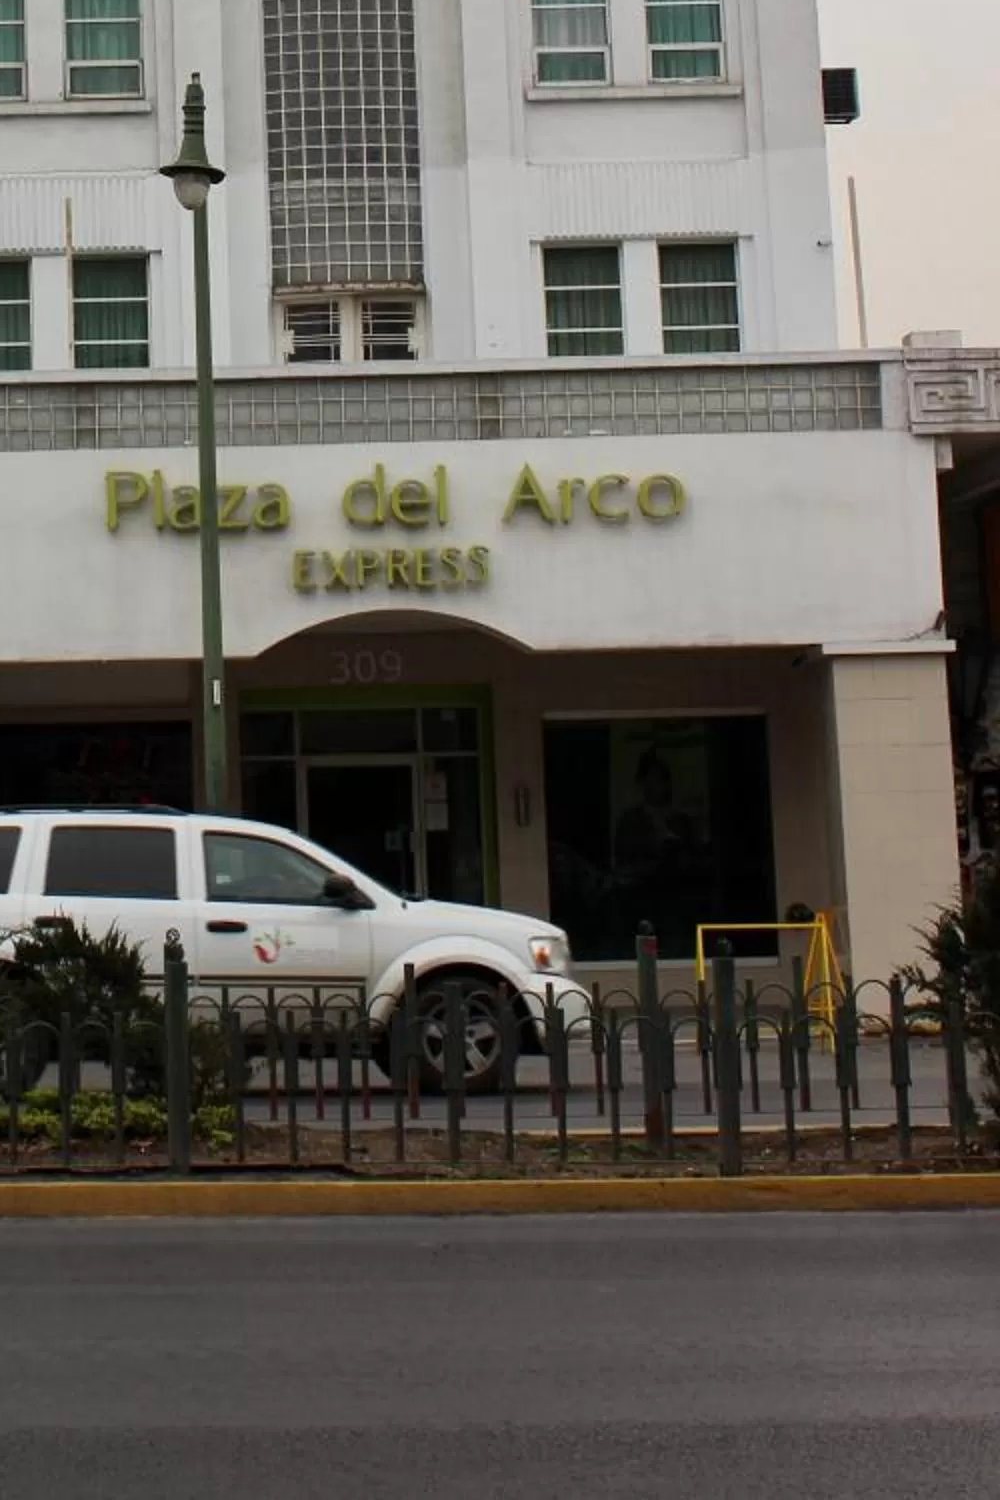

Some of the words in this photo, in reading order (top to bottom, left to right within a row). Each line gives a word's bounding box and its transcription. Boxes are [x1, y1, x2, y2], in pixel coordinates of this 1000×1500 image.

[105, 469, 291, 533] Plaza
[342, 463, 448, 527] del
[501, 463, 687, 524] Arco
[292, 545, 490, 591] EXPRESS
[329, 651, 403, 686] 309
